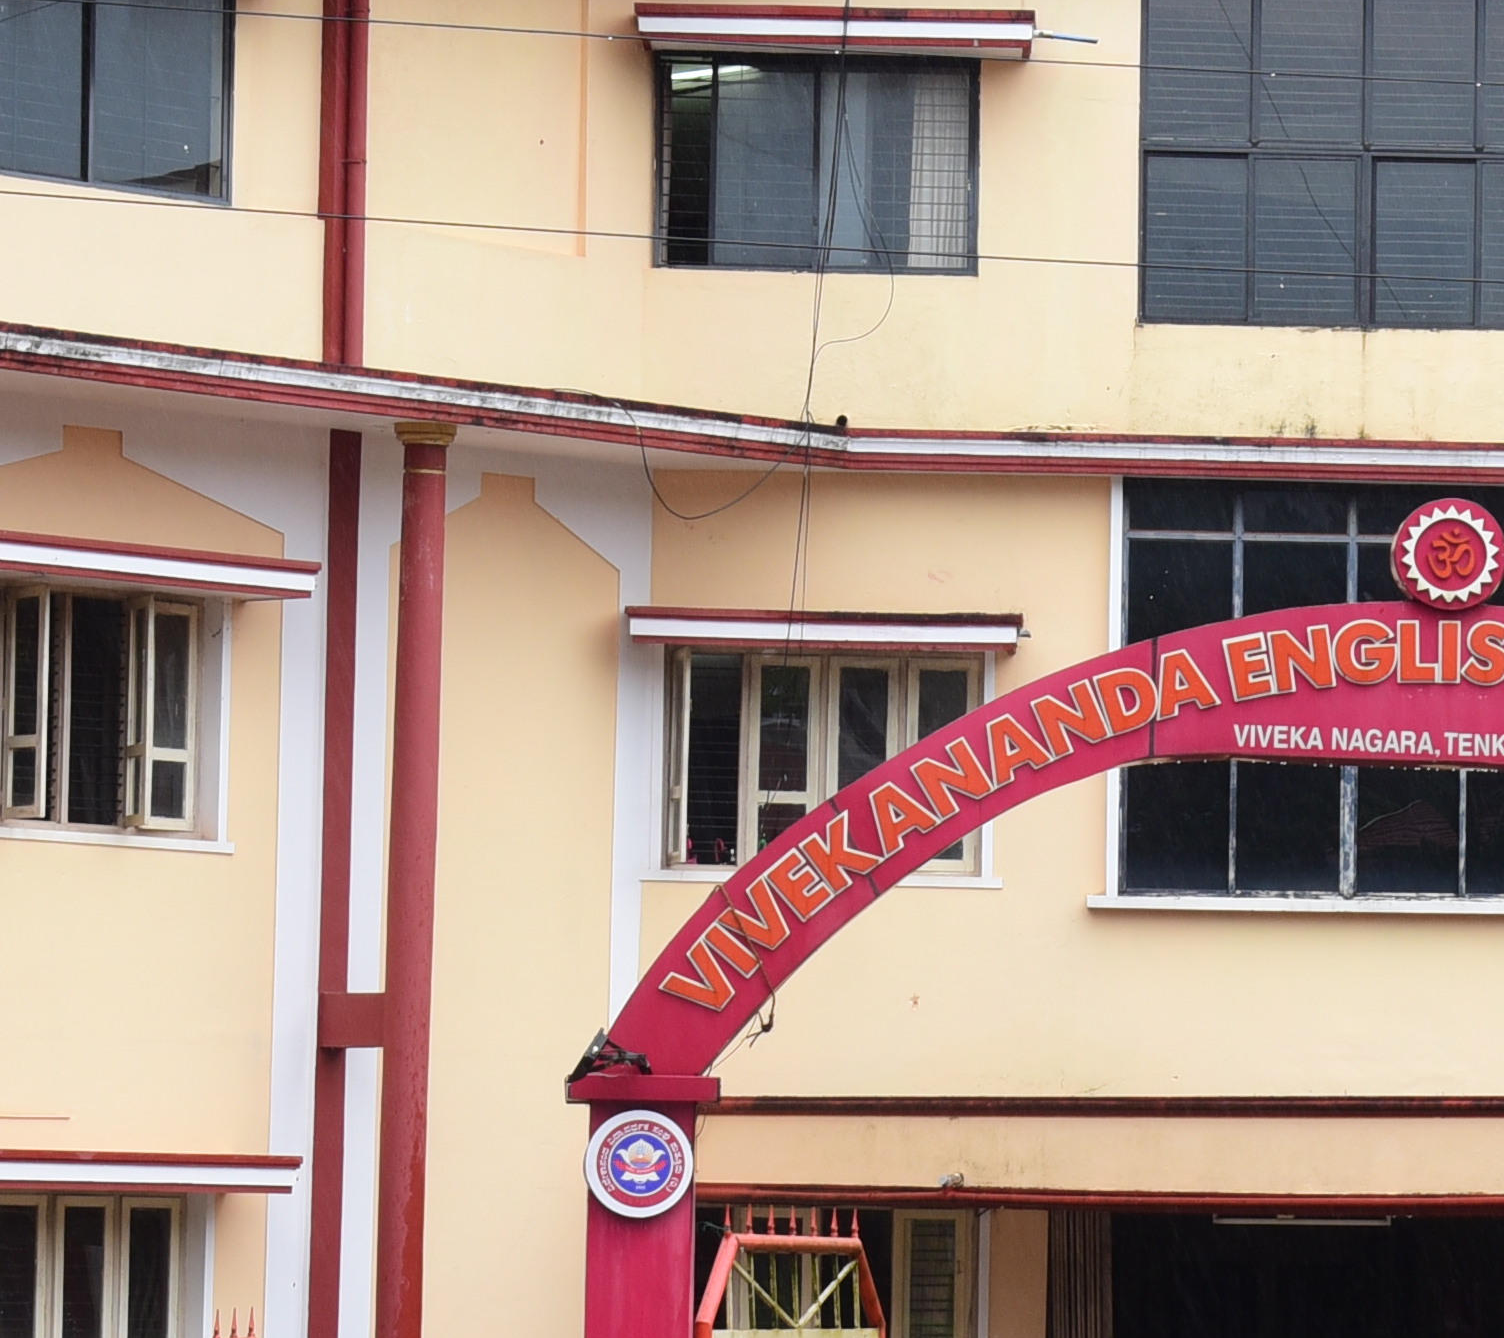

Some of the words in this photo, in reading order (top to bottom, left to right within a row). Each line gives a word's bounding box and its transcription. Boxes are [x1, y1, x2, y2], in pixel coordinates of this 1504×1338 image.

[658, 648, 1221, 1012] VIVEKANANDA
[1233, 723, 1324, 751] VIVEKA
[1331, 726, 1441, 757] NAGARA,
